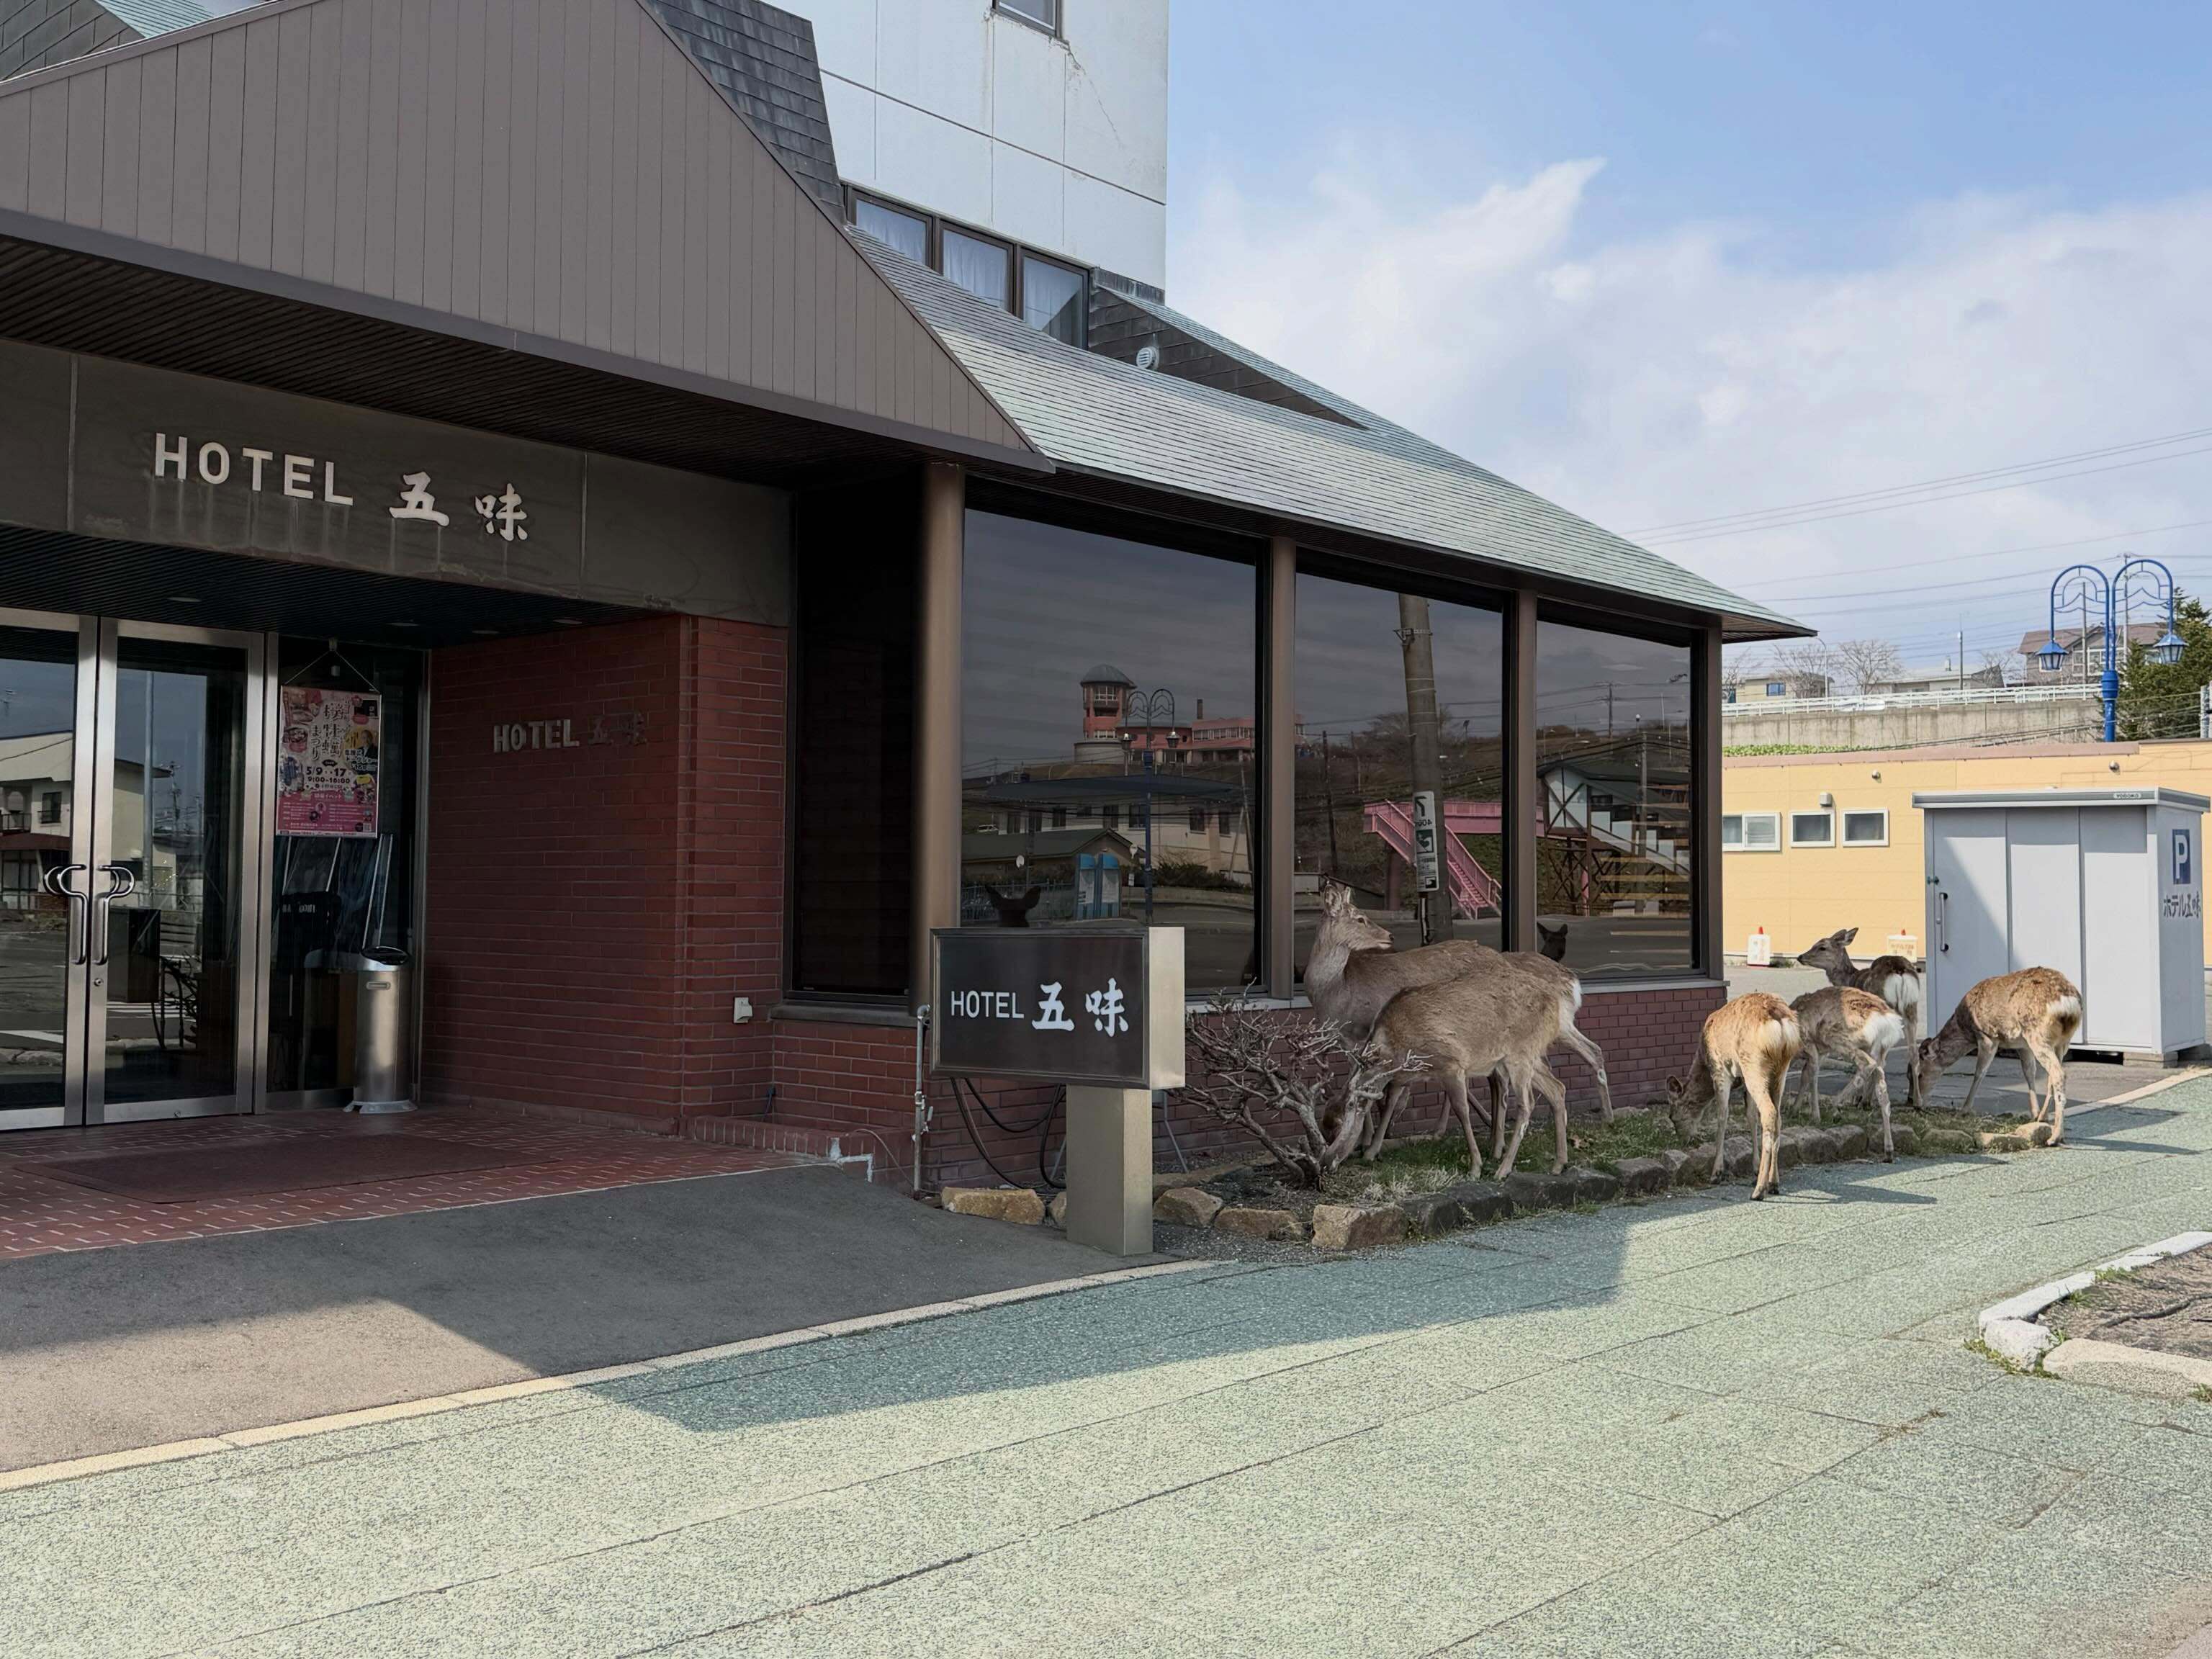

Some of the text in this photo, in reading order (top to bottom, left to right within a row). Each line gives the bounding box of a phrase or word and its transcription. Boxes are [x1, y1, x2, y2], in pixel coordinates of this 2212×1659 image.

[153, 432, 529, 541] HOTEL 五味
[493, 718, 580, 754] HOTEL
[2175, 835, 2188, 879] P
[2163, 891, 2201, 919] ホテル五味
[950, 977, 1129, 1038] HOTEL 五味
